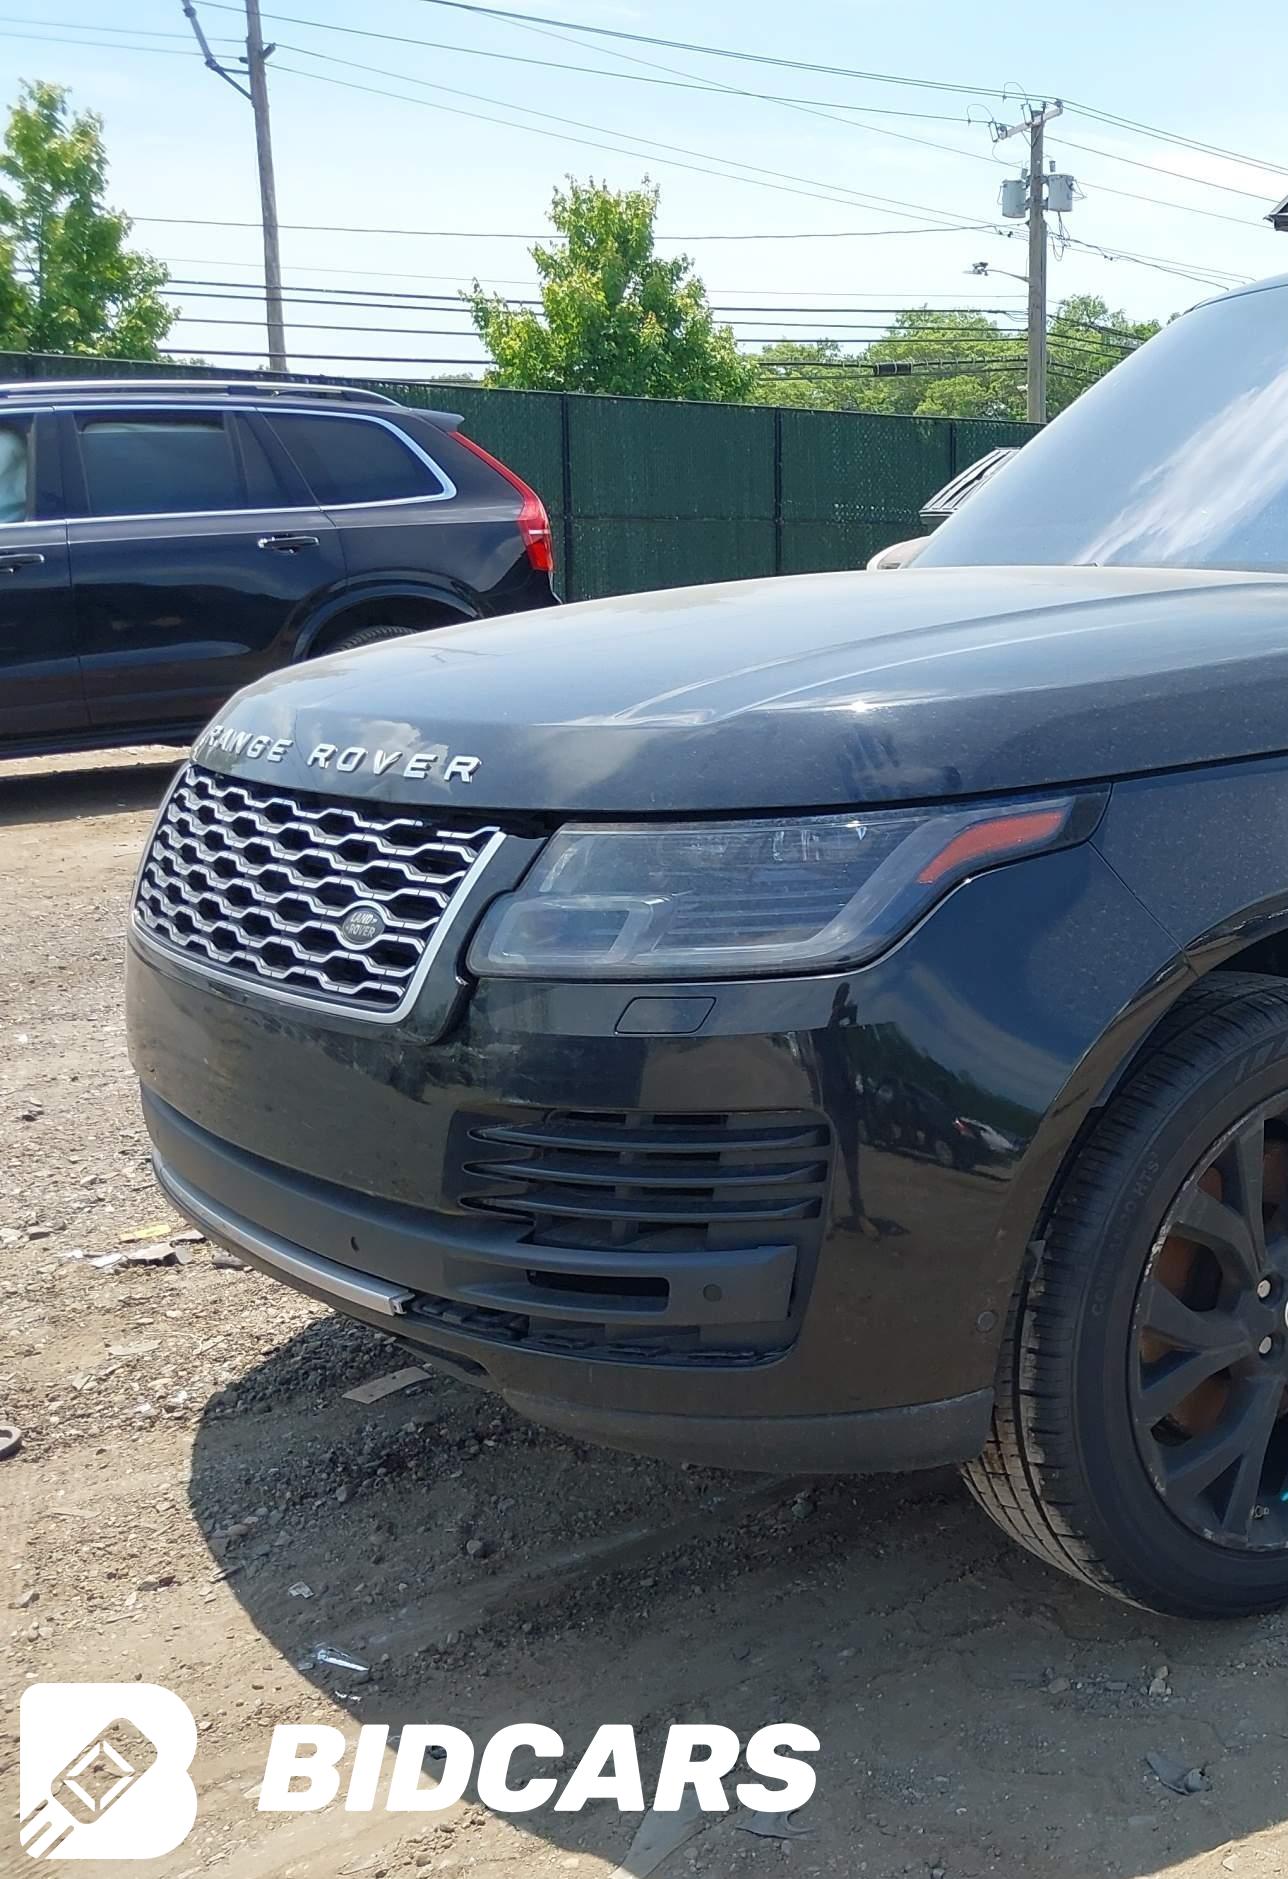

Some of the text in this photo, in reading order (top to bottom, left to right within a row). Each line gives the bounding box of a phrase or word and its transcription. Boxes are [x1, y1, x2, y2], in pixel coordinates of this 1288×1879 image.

[201, 725, 482, 783] RANGE ROVER
[351, 911, 374, 925] LAND
[348, 923, 376, 937] ROVER
